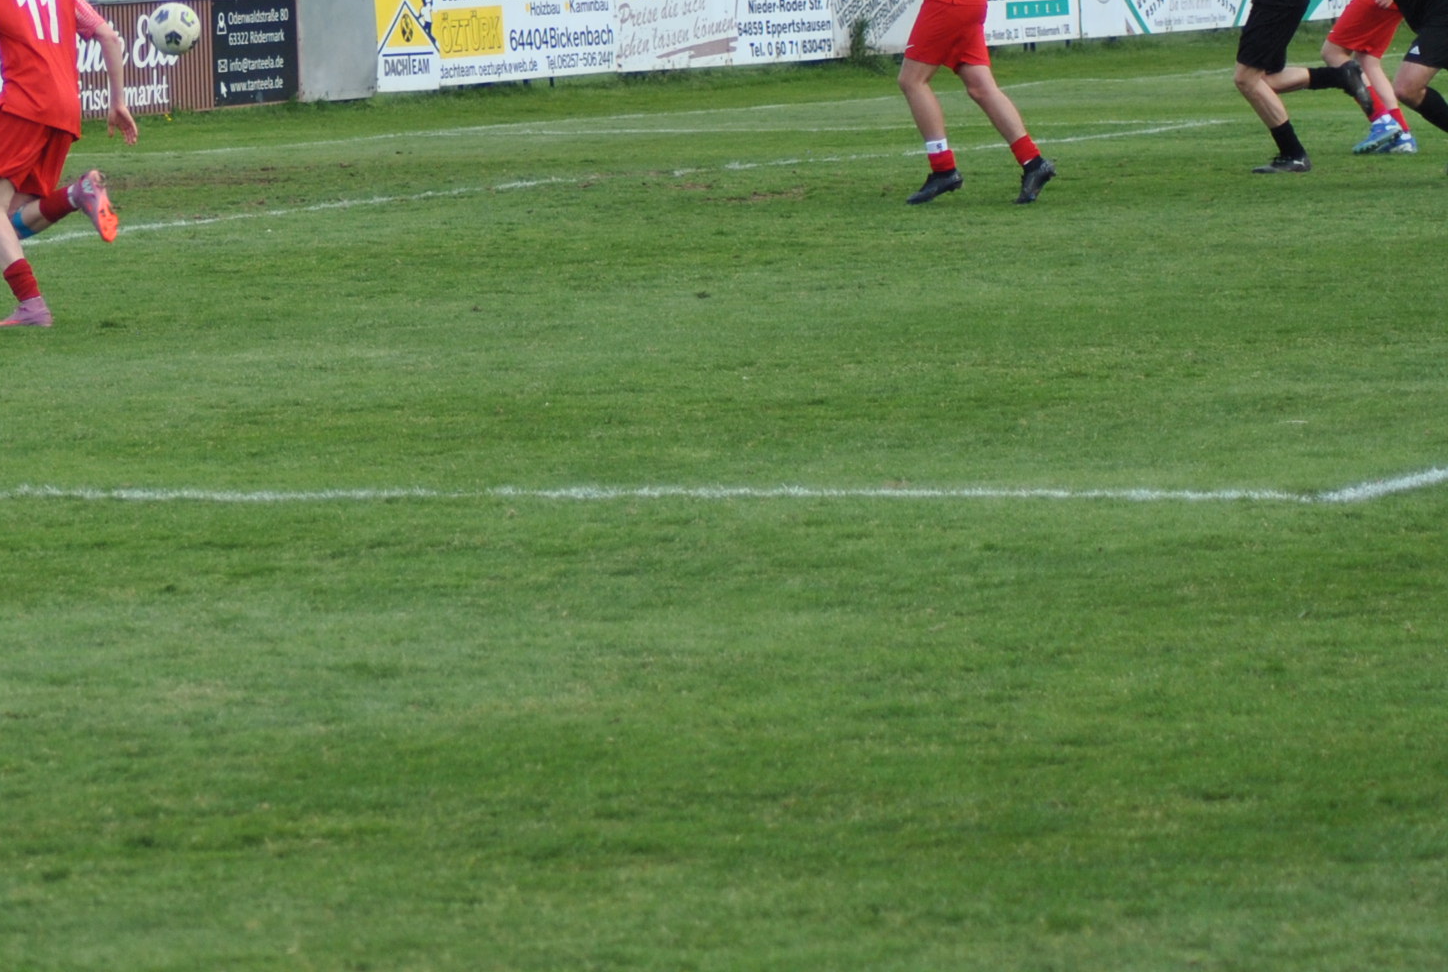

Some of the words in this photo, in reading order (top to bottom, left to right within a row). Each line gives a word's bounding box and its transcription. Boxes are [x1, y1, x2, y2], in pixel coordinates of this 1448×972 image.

[228, 8, 279, 25] Odenwaldstraße
[280, 8, 289, 21] 80
[529, 2, 561, 16] Holzbau
[228, 31, 249, 45] 63322
[250, 28, 285, 44] Rödermark
[441, 10, 502, 54] ÖZTÜRK
[737, 21, 763, 37] 64859
[766, 18, 831, 38] Eppertshausen
[749, 42, 766, 57] Tel.
[230, 75, 284, 93] www.tanteela.de
